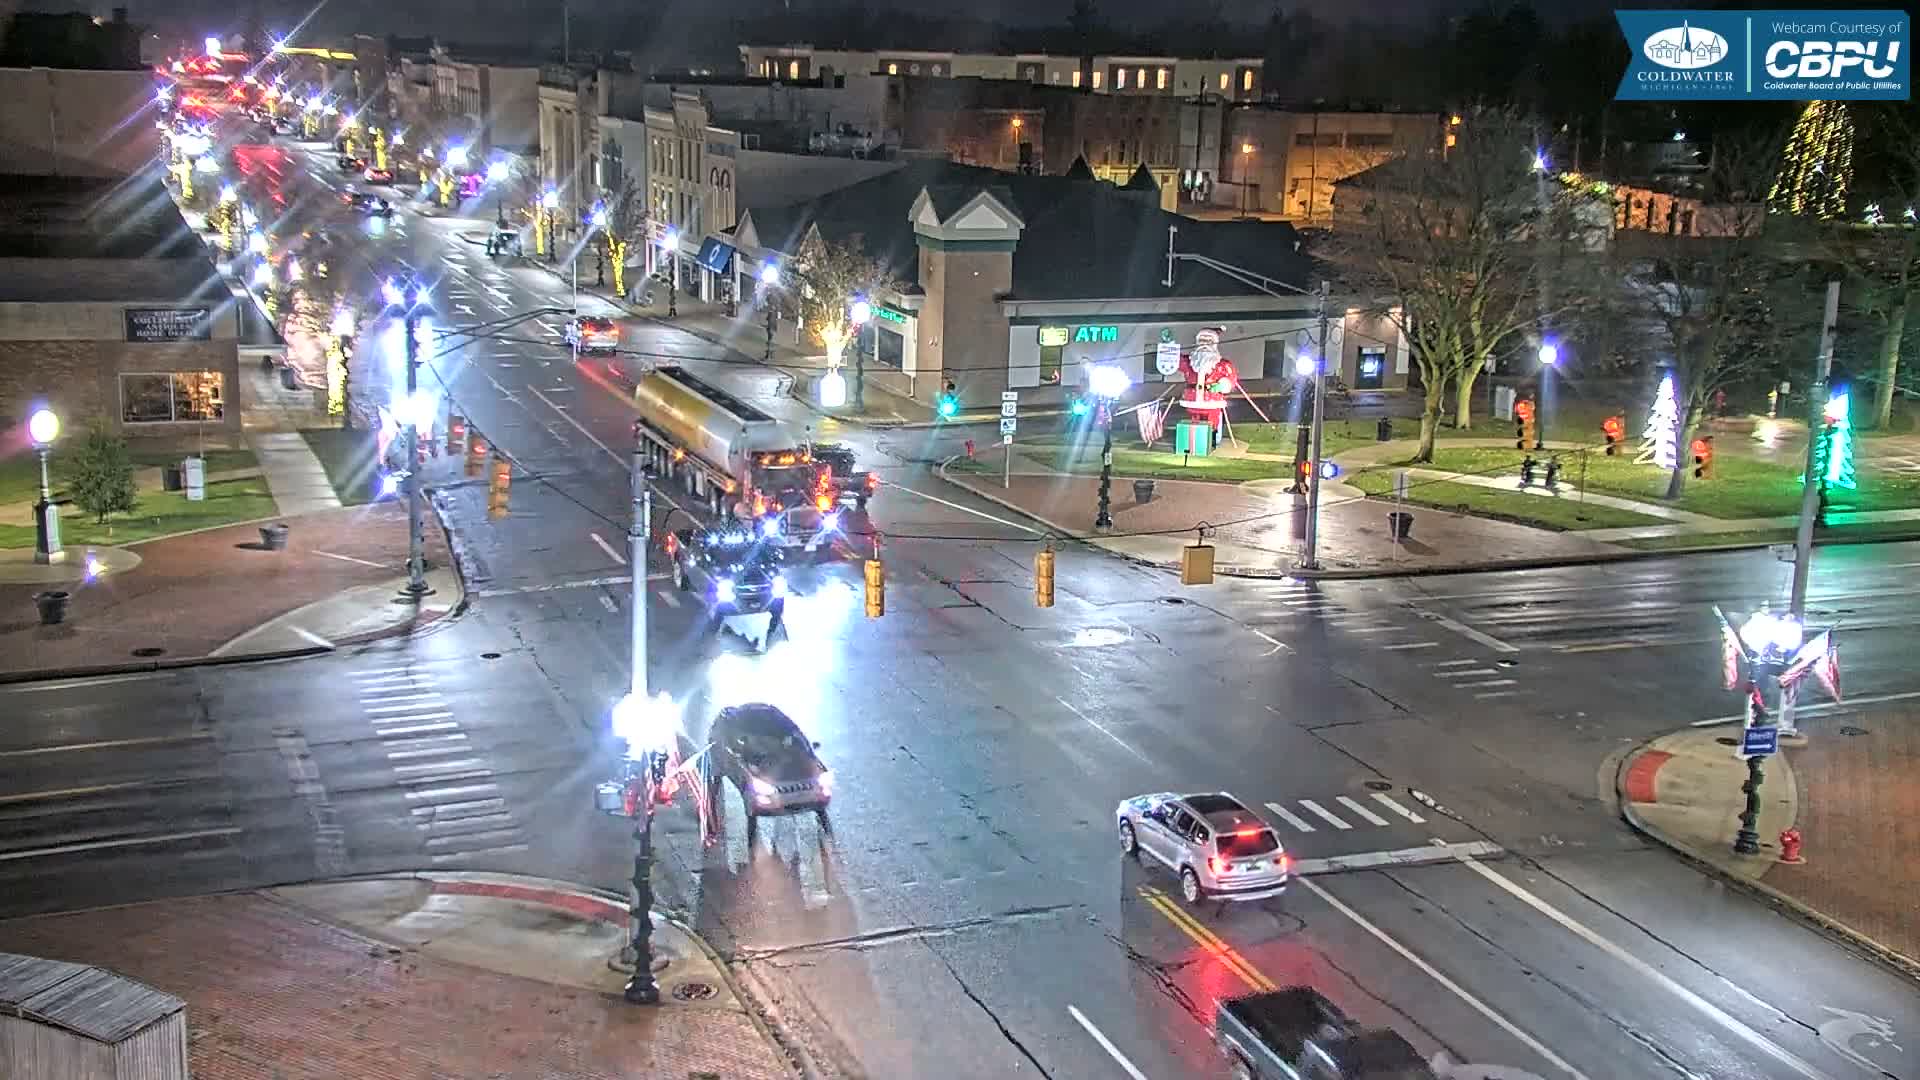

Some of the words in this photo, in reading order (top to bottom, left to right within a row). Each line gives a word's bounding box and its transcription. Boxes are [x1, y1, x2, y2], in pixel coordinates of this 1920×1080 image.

[136, 329, 162, 337] HOME
[1075, 326, 1117, 343] ATM
[1005, 403, 1014, 414] 12
